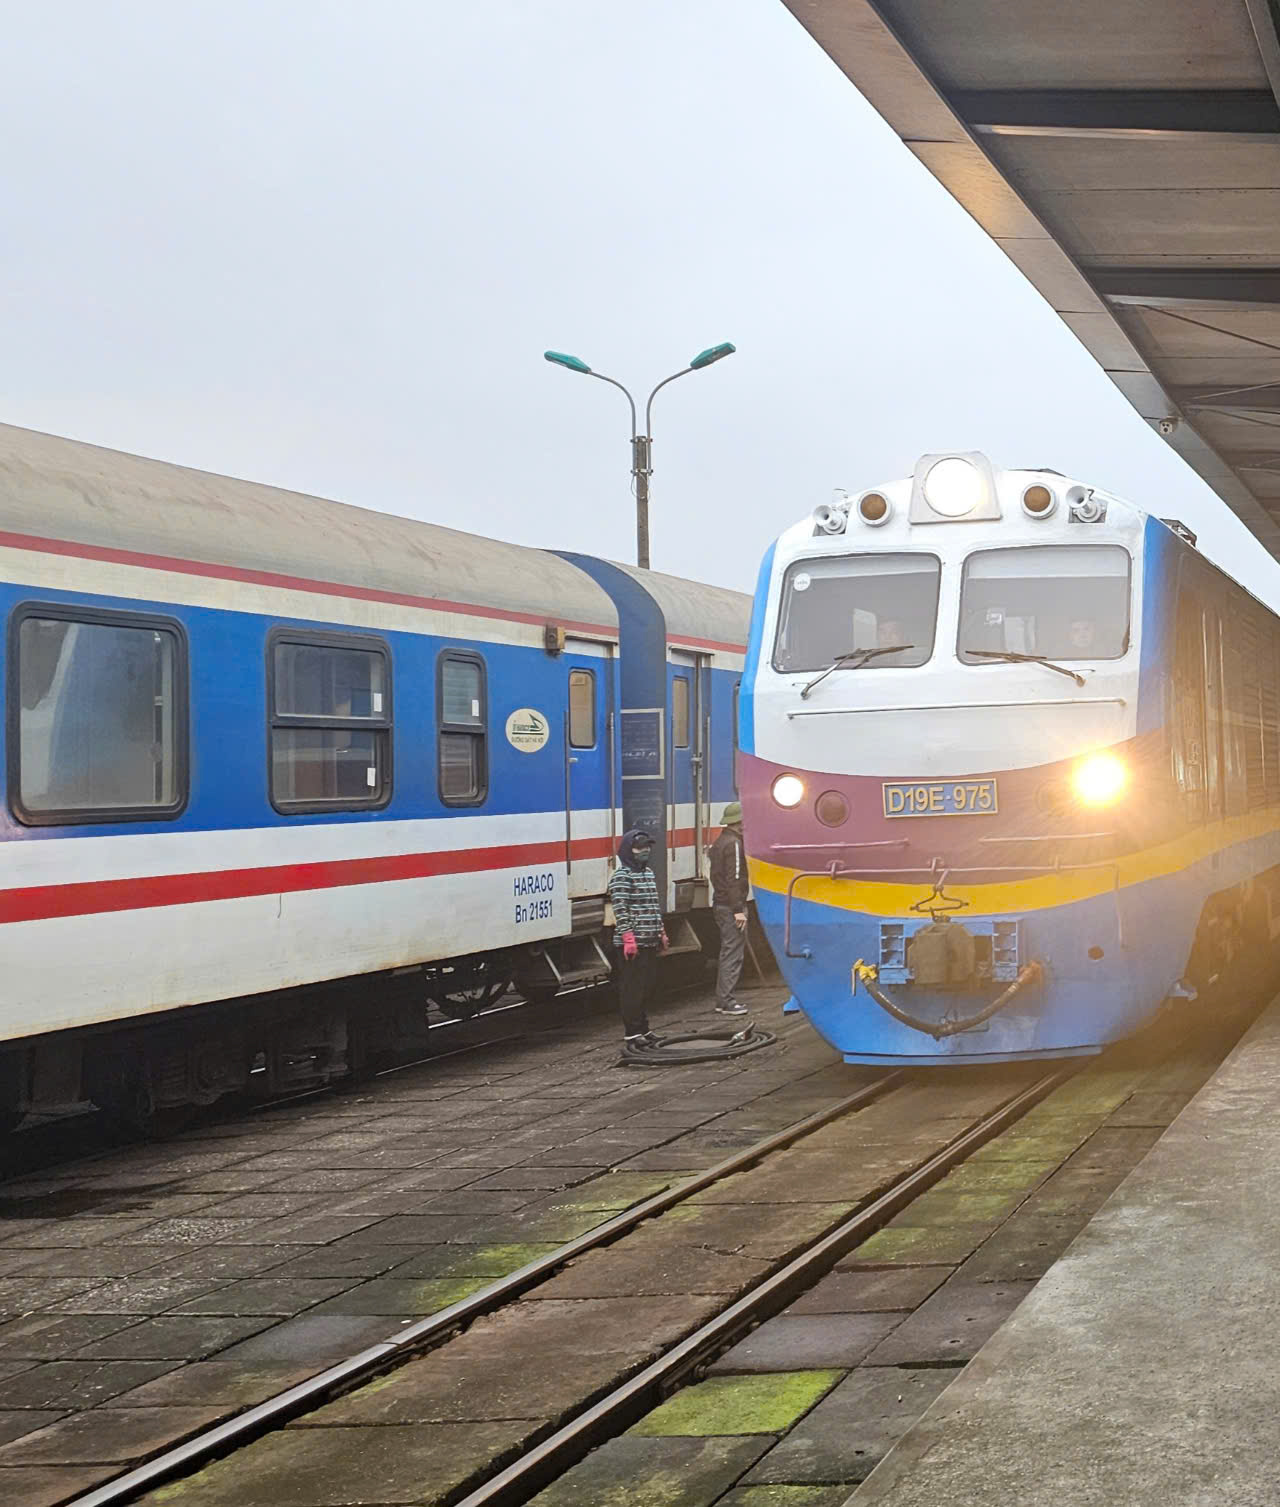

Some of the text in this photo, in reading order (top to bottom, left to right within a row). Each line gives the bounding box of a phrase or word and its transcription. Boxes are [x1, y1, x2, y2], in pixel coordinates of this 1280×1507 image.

[513, 873, 554, 897] HARACO
[515, 899, 553, 924] Bn 21551
